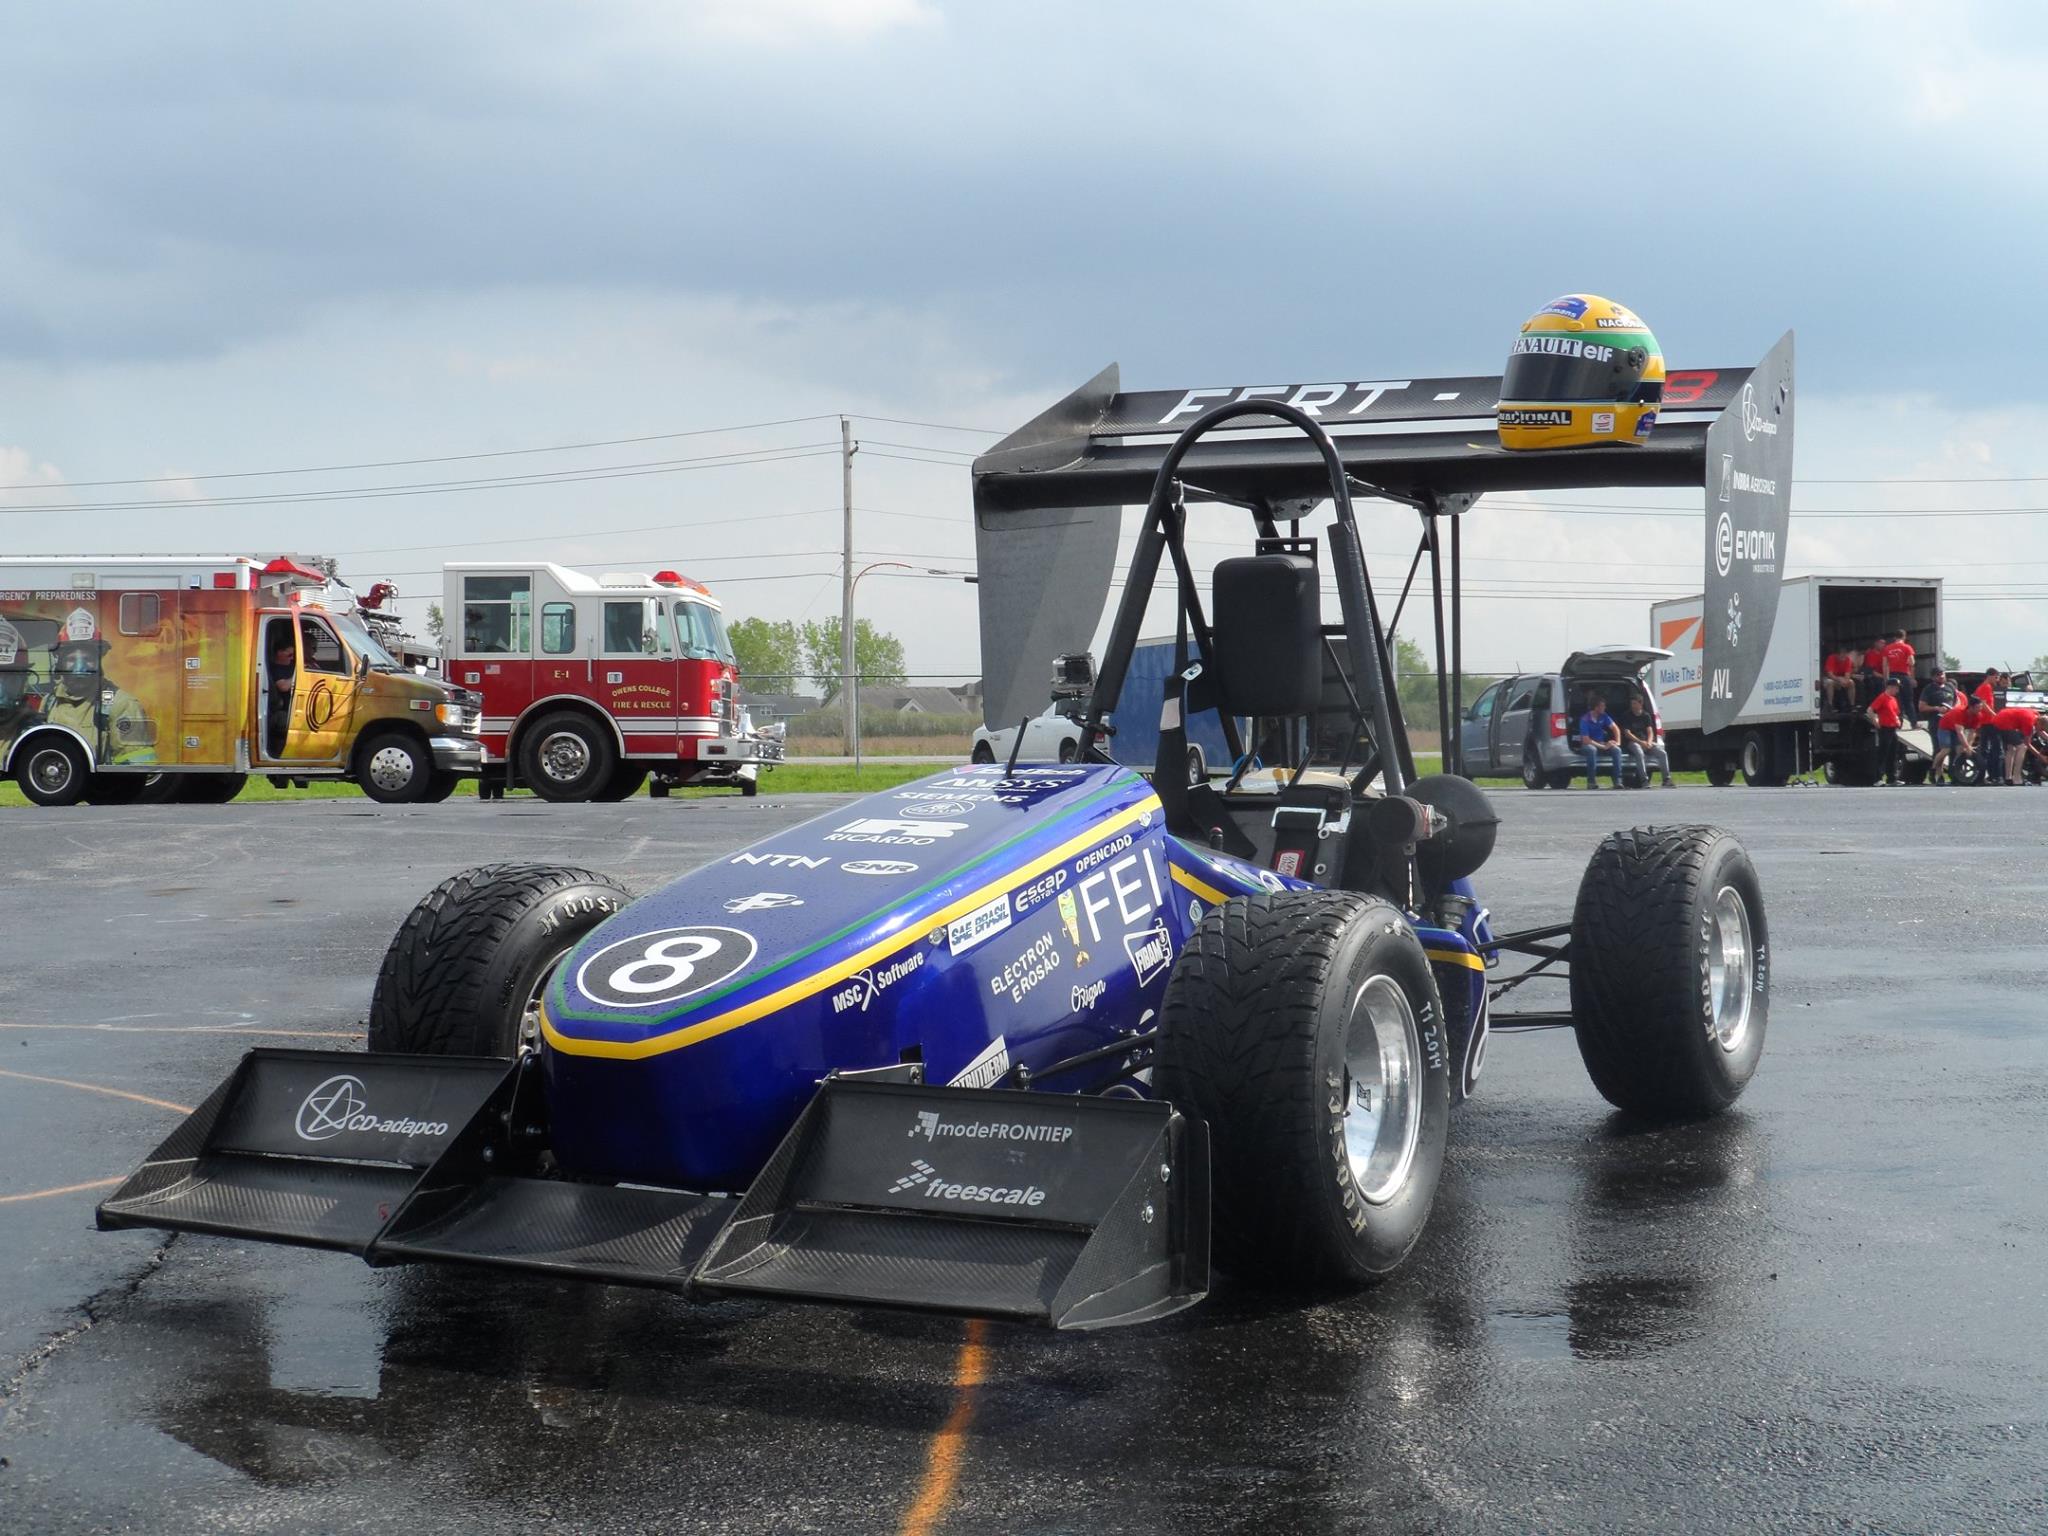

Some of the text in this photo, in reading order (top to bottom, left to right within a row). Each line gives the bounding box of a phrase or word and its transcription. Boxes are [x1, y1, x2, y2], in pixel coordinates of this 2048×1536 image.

[1582, 343, 1614, 363] elf
[35, 591, 97, 601] PREPAREDNESS
[1660, 668, 1680, 683] Make
[1681, 666, 1696, 681] The
[1710, 668, 1733, 700] AVL
[611, 684, 672, 697] OWENS COLLEGE
[612, 700, 672, 709] FIRE & RESCUE
[931, 777, 1058, 790] ANSYS
[893, 791, 1030, 804] SIEMENS
[822, 832, 936, 846] RICARDO
[729, 852, 832, 870] NTN
[1078, 847, 1164, 943] FEI
[951, 902, 1009, 946] SAE BRASIL
[608, 935, 723, 994] 8
[832, 951, 924, 1014] MSC Software
[1419, 1001, 1435, 1023] T1
[1424, 1025, 1442, 1070] 2014
[347, 1113, 449, 1138] CD-adapco
[924, 1177, 1046, 1206] freescale
